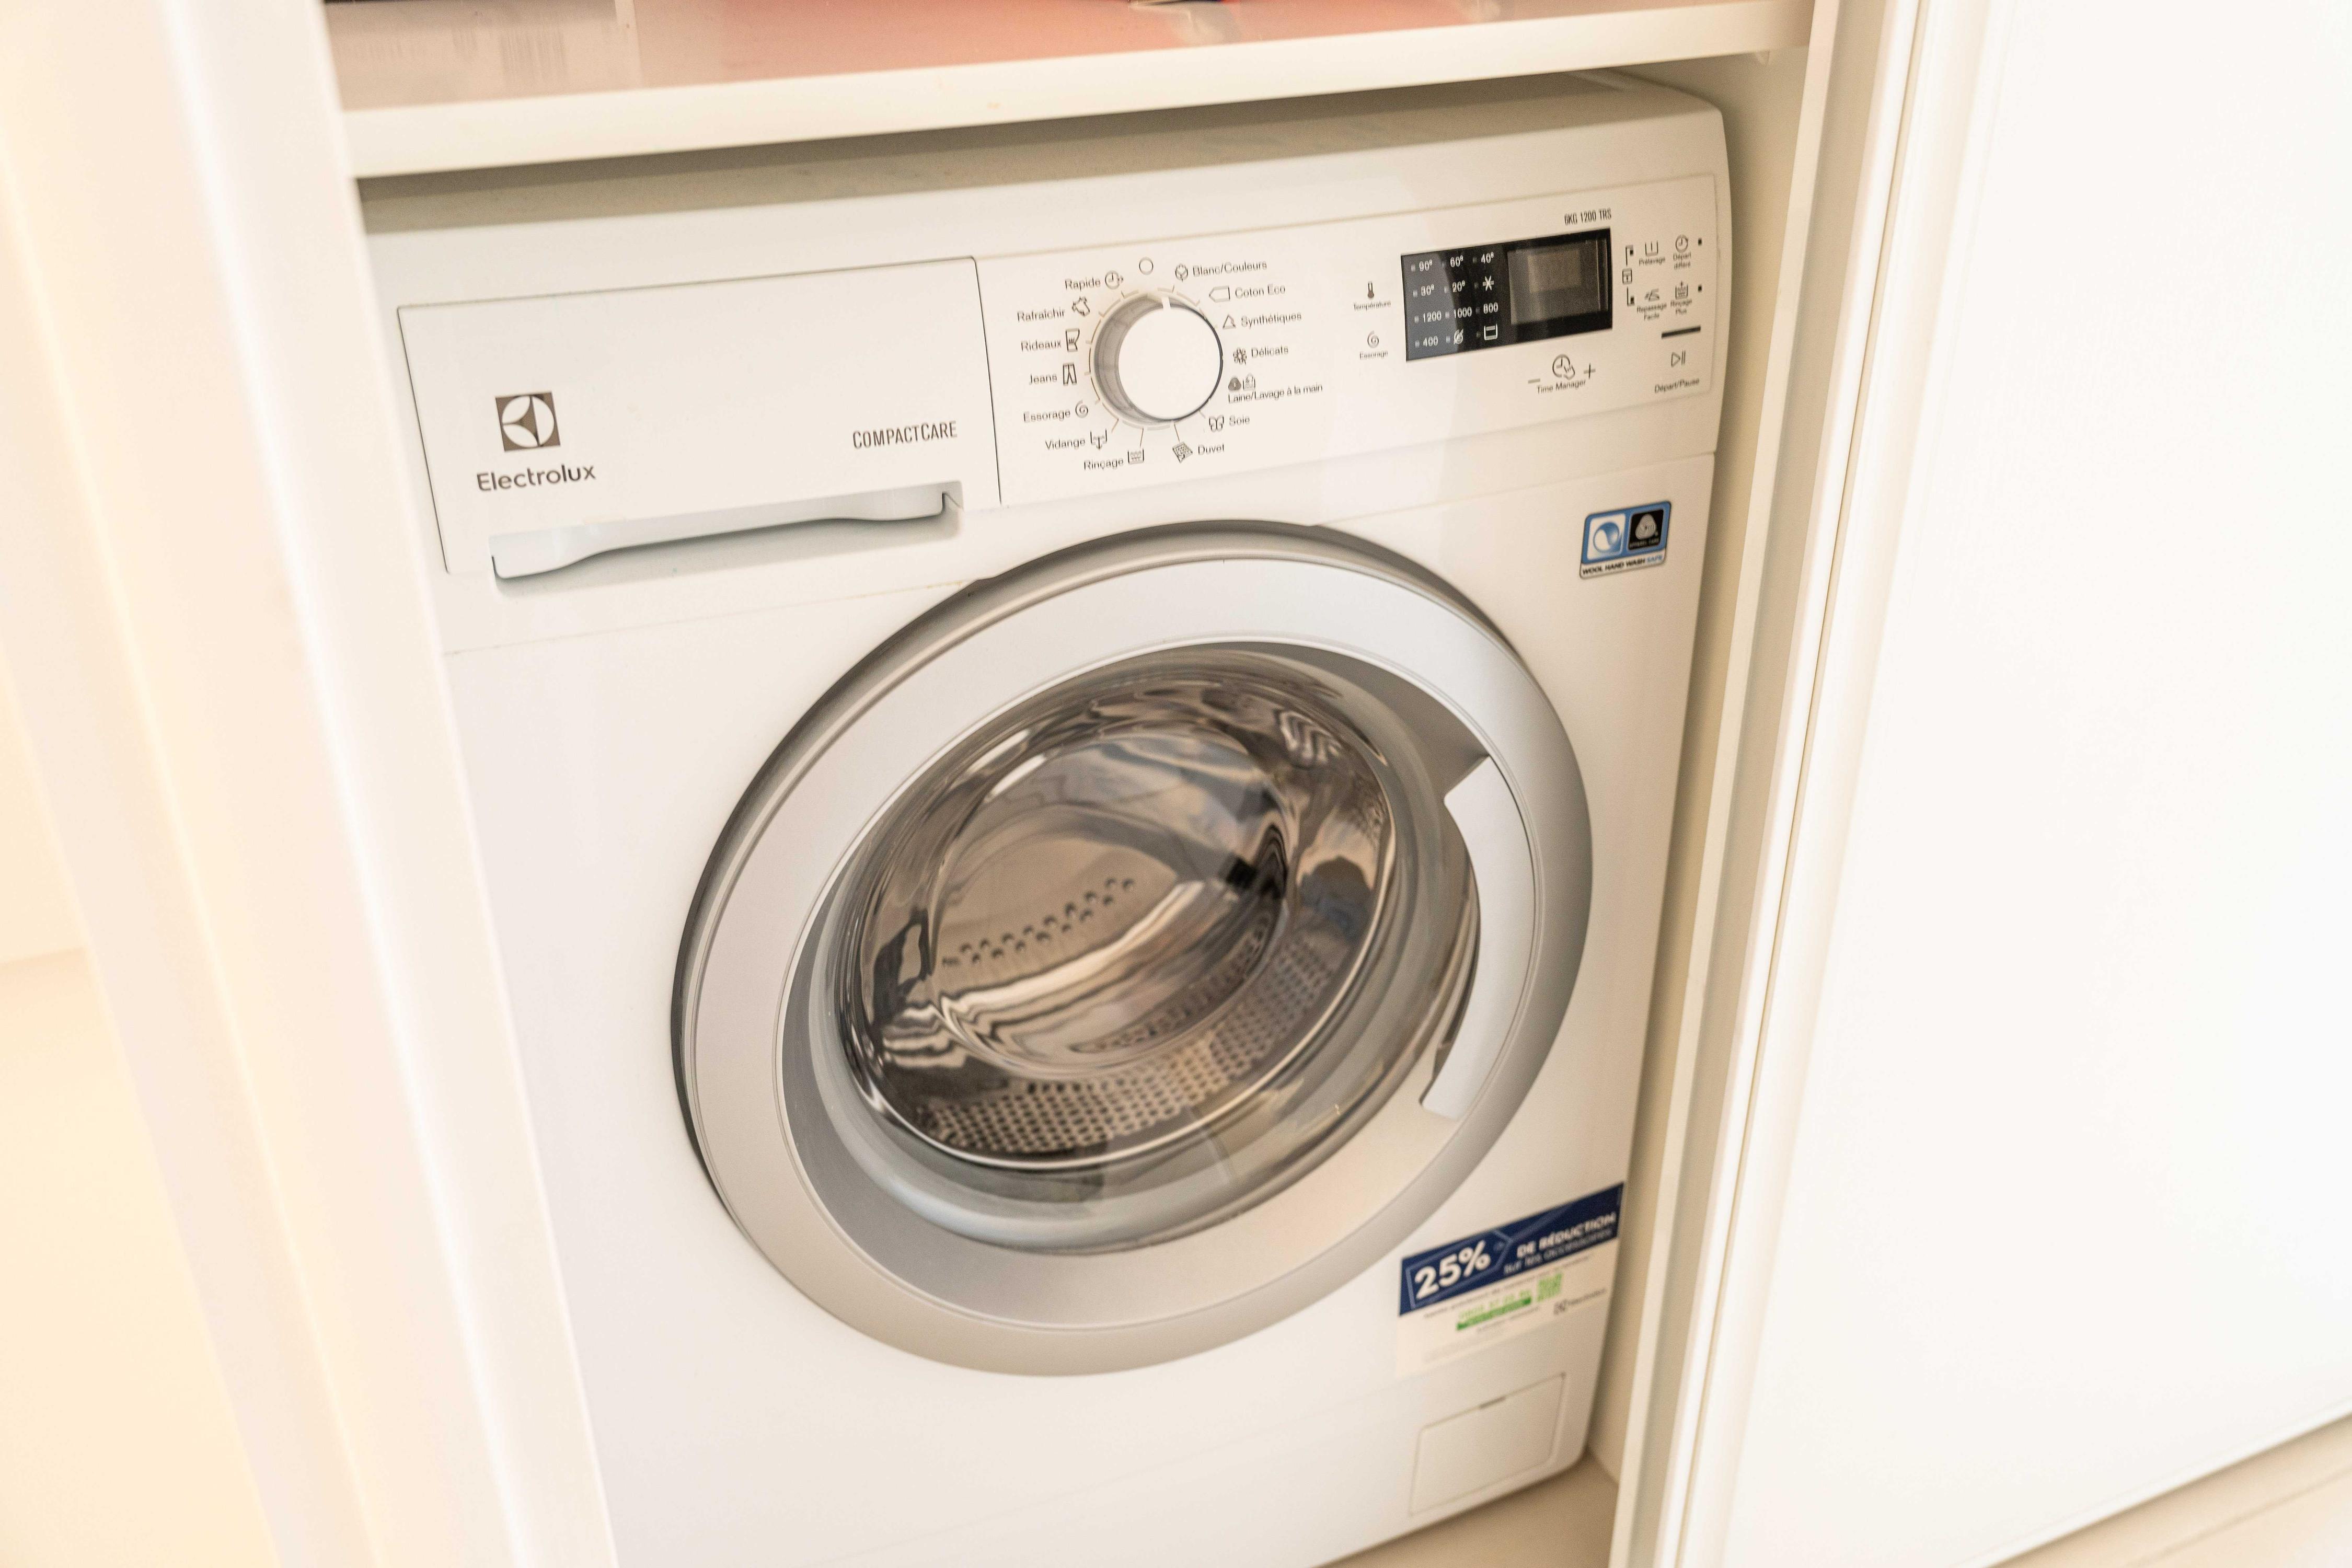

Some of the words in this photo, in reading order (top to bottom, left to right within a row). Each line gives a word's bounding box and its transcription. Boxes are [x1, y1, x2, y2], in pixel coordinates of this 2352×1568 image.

[1581, 210, 1596, 223] 1200
[1599, 208, 1611, 221] TRS
[1193, 260, 1267, 277] Blanc/Couleurs
[1065, 278, 1101, 291] Rapide
[1235, 286, 1264, 298] Coton
[1267, 284, 1285, 295] Eco
[1353, 301, 1391, 312] Température
[1423, 310, 1442, 322] 1200
[1454, 306, 1472, 319] 1000
[1483, 302, 1498, 314] 800
[1017, 308, 1065, 322] Rafraîchir
[1241, 312, 1302, 327] Synthétiques
[1021, 339, 1062, 352] Rideaux
[1423, 336, 1438, 347] 400
[1251, 345, 1289, 359] Délicats
[1359, 351, 1388, 360] Essorage
[1029, 373, 1057, 385] Jeans
[1654, 377, 1700, 393] Départ/Pause
[1228, 389, 1284, 403] Laine/Lavage
[1287, 387, 1292, 396] à
[1295, 385, 1300, 395] la
[1304, 382, 1322, 394] main
[1537, 383, 1553, 394] Time
[1555, 379, 1586, 391] Manager
[1023, 409, 1070, 423] Essorage
[1229, 416, 1250, 426] Soie
[1045, 436, 1086, 450] Vidange
[1198, 443, 1225, 455] Duvet
[1084, 458, 1124, 470] Rinçage
[476, 464, 597, 492] Electrolux
[1582, 567, 1602, 575] WOOL
[1605, 562, 1624, 571] HAND
[1626, 558, 1646, 567] WASH
[1517, 1240, 1537, 1259] DE
[1414, 1239, 1492, 1300] 25%
